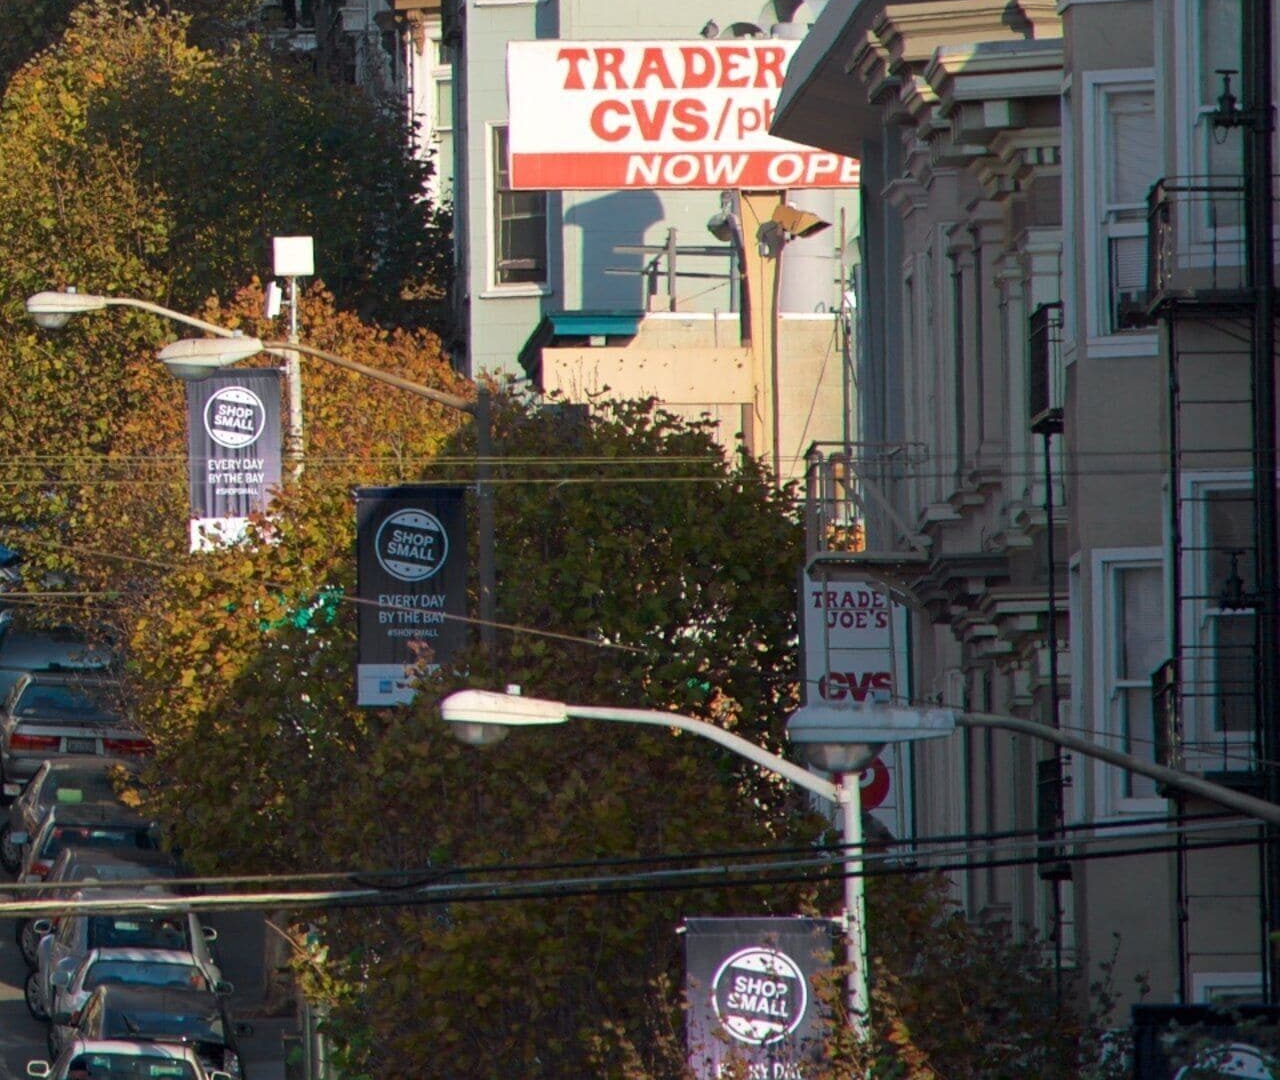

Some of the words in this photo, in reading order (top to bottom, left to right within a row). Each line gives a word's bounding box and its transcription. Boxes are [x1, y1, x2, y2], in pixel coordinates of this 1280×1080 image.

[557, 47, 785, 90] TRADER
[626, 154, 750, 185] NOW
[218, 404, 253, 418] SHOP
[214, 415, 254, 431] SMALL
[208, 459, 241, 470] EVERY
[243, 459, 264, 470] DAY
[208, 472, 222, 483] BY
[224, 472, 243, 483] THE
[245, 472, 264, 483] BAY
[392, 529, 434, 546] SHOP
[387, 542, 435, 561] SMALL
[379, 595, 418, 607] EVERY
[421, 595, 446, 607] DAY
[812, 591, 901, 608] TRADE
[379, 611, 395, 624] BY
[397, 611, 420, 624] THE
[423, 611, 446, 624] BAY
[826, 610, 889, 628] JOE'S
[819, 672, 892, 702] CVS
[735, 976, 788, 999] SHOP
[727, 992, 789, 1017] SMALL
